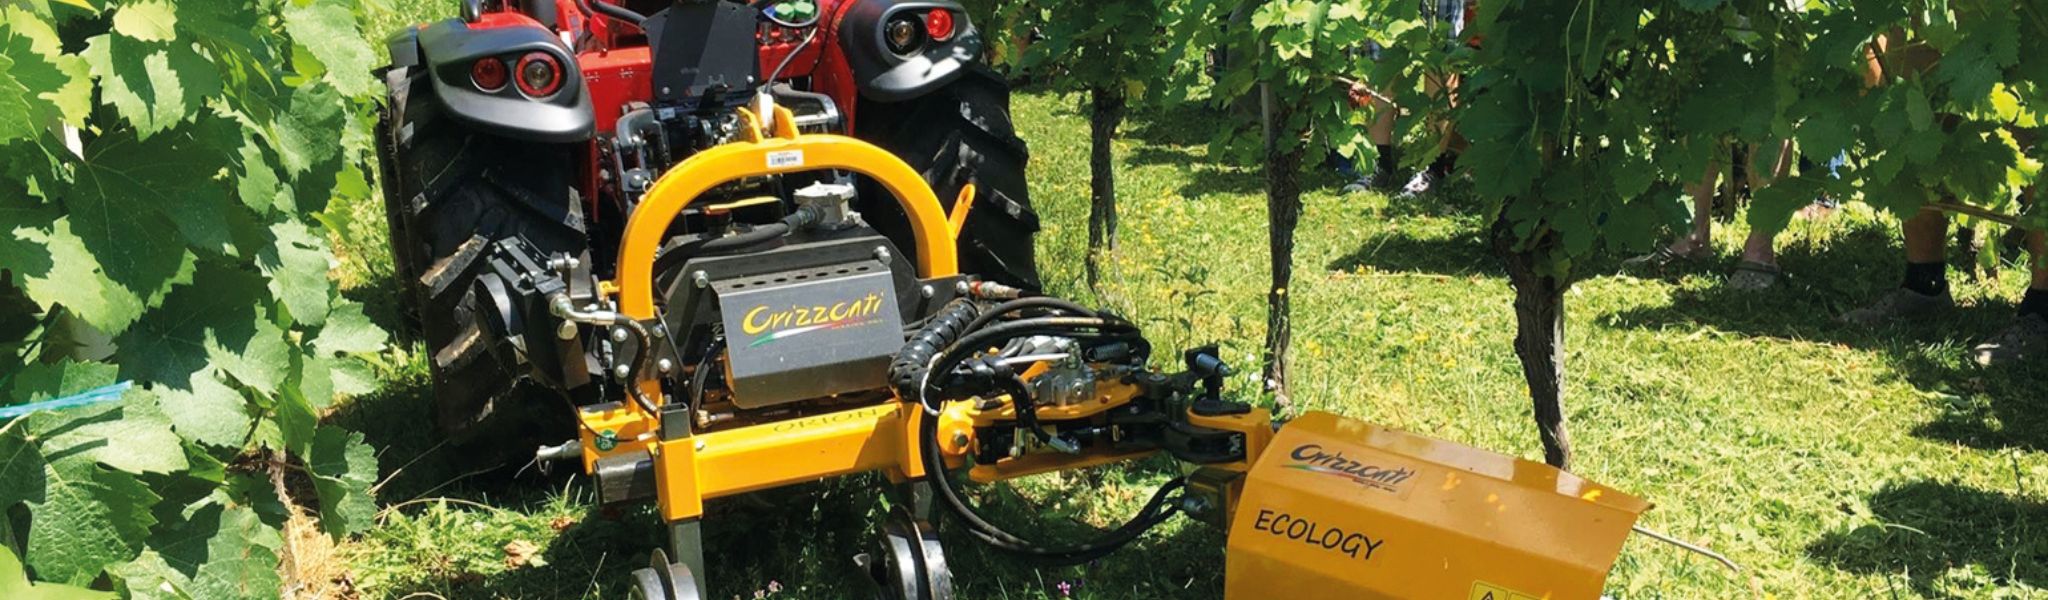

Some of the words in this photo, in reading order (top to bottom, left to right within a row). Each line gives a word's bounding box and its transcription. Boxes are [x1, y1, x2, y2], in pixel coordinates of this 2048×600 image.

[742, 291, 885, 335] Orizzonti
[774, 408, 877, 433] ORION
[1290, 444, 1415, 485] Orizzonti
[1254, 509, 1384, 560] ECOLOGY
